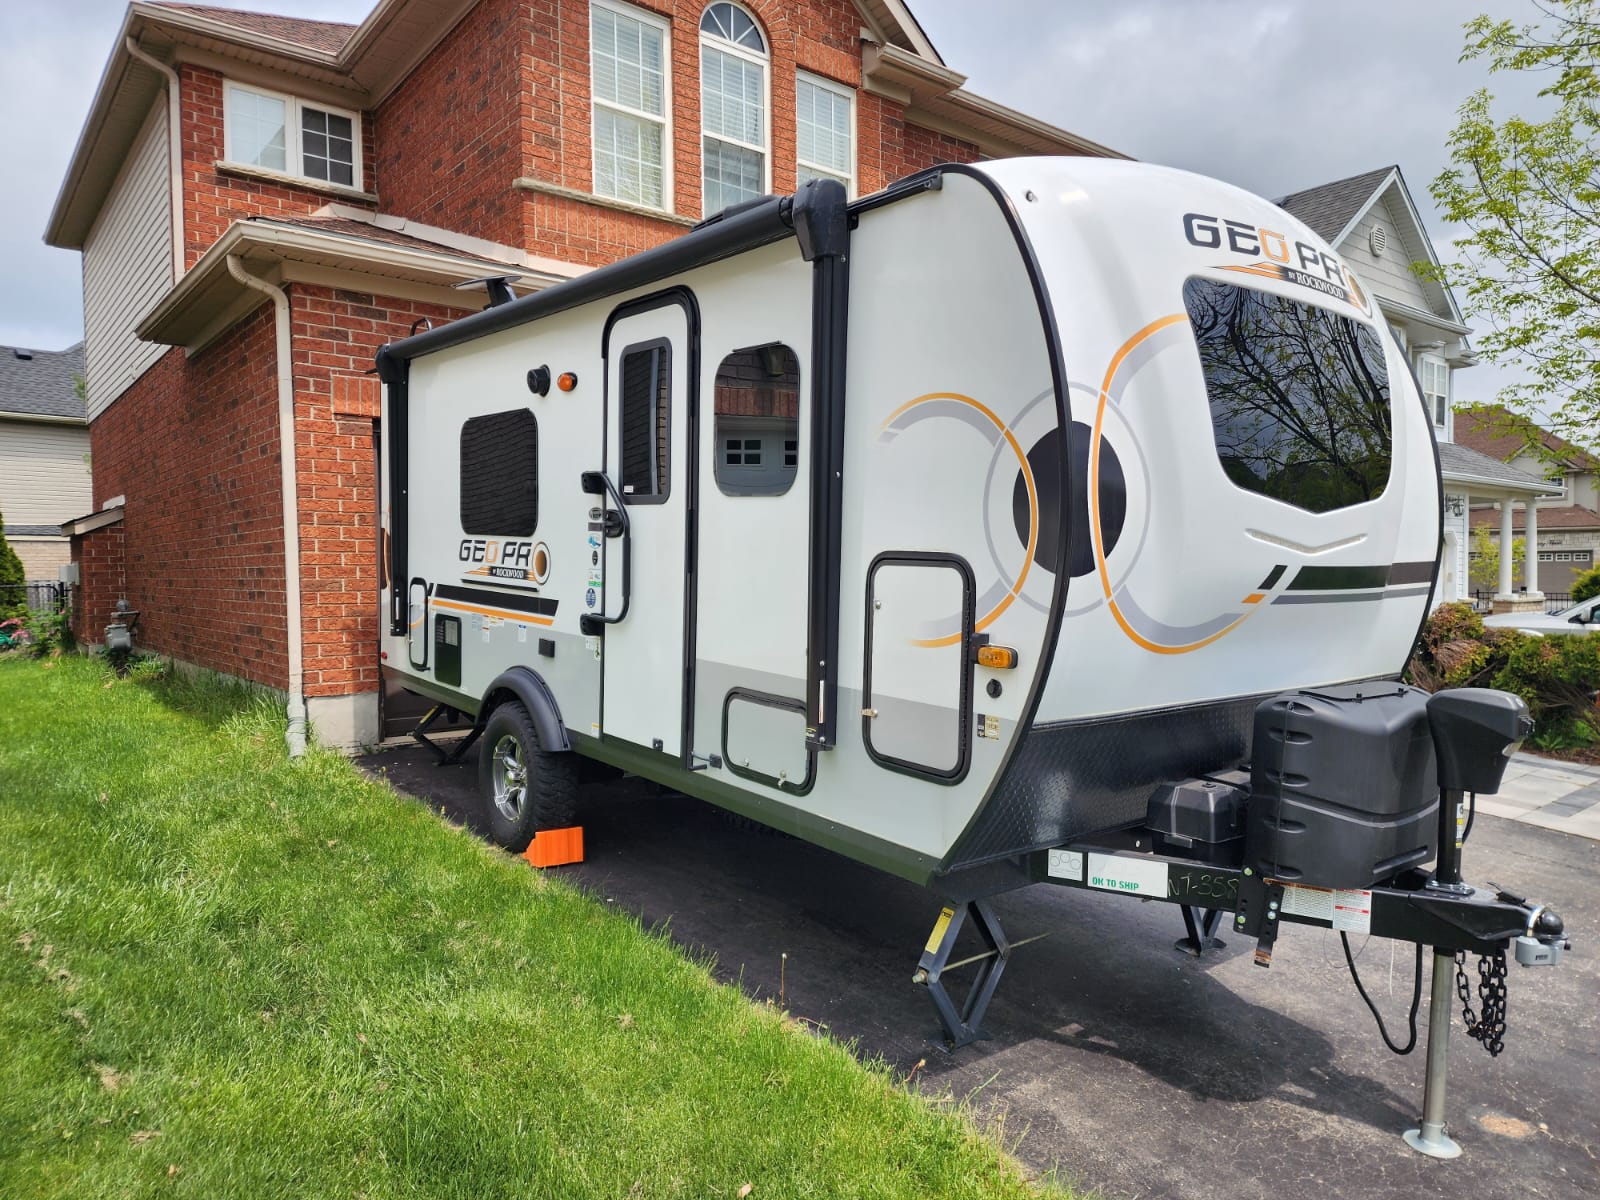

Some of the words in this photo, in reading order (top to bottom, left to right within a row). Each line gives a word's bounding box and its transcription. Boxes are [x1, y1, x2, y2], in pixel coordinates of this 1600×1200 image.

[1183, 212, 1290, 264] GEO
[1295, 271, 1344, 299] ROCKWOOD
[459, 539, 499, 563] GEO
[501, 541, 551, 586] PRO
[1092, 876, 1104, 886] OK
[1106, 878, 1116, 888] TO
[1118, 880, 1139, 891] SHIP
